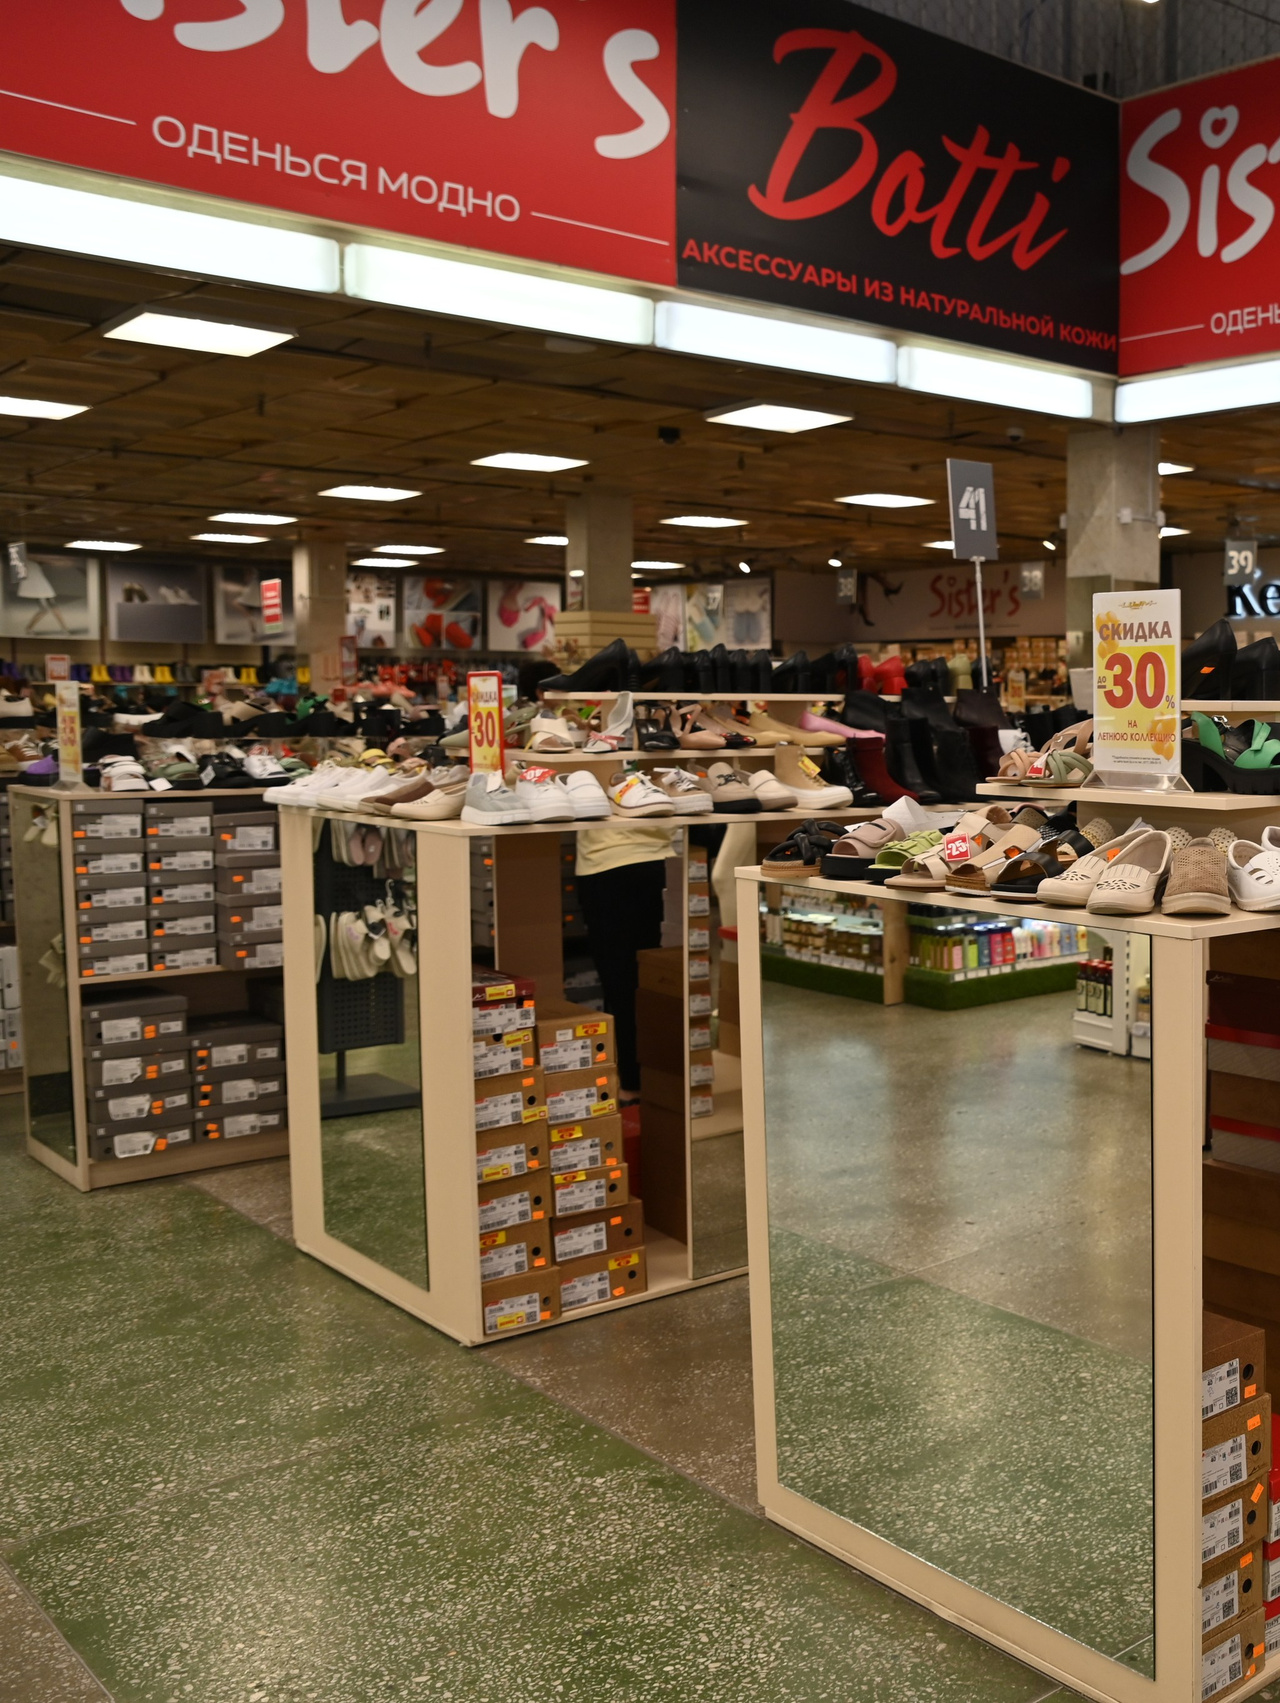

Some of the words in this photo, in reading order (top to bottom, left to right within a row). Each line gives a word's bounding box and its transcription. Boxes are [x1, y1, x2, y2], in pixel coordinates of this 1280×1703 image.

[748, 27, 1070, 270] Botti
[152, 115, 367, 191] ОДЕНЬСЯ
[378, 167, 519, 221] МОДНО
[682, 239, 857, 295] АКСЕССУАРЫ
[864, 277, 894, 302] ИЗ
[900, 286, 1054, 339] НАТУРАЛЬНОЙ
[1059, 323, 1117, 352] КОЖИ
[958, 486, 988, 532] 41
[1227, 550, 1253, 575] 39
[1100, 620, 1172, 642] СКИДКА
[1098, 732, 1128, 742] ЛЕТНЮЮ
[1130, 732, 1176, 743] КОЛЛЕКЦИЮ
[1127, 720, 1138, 728] НА
